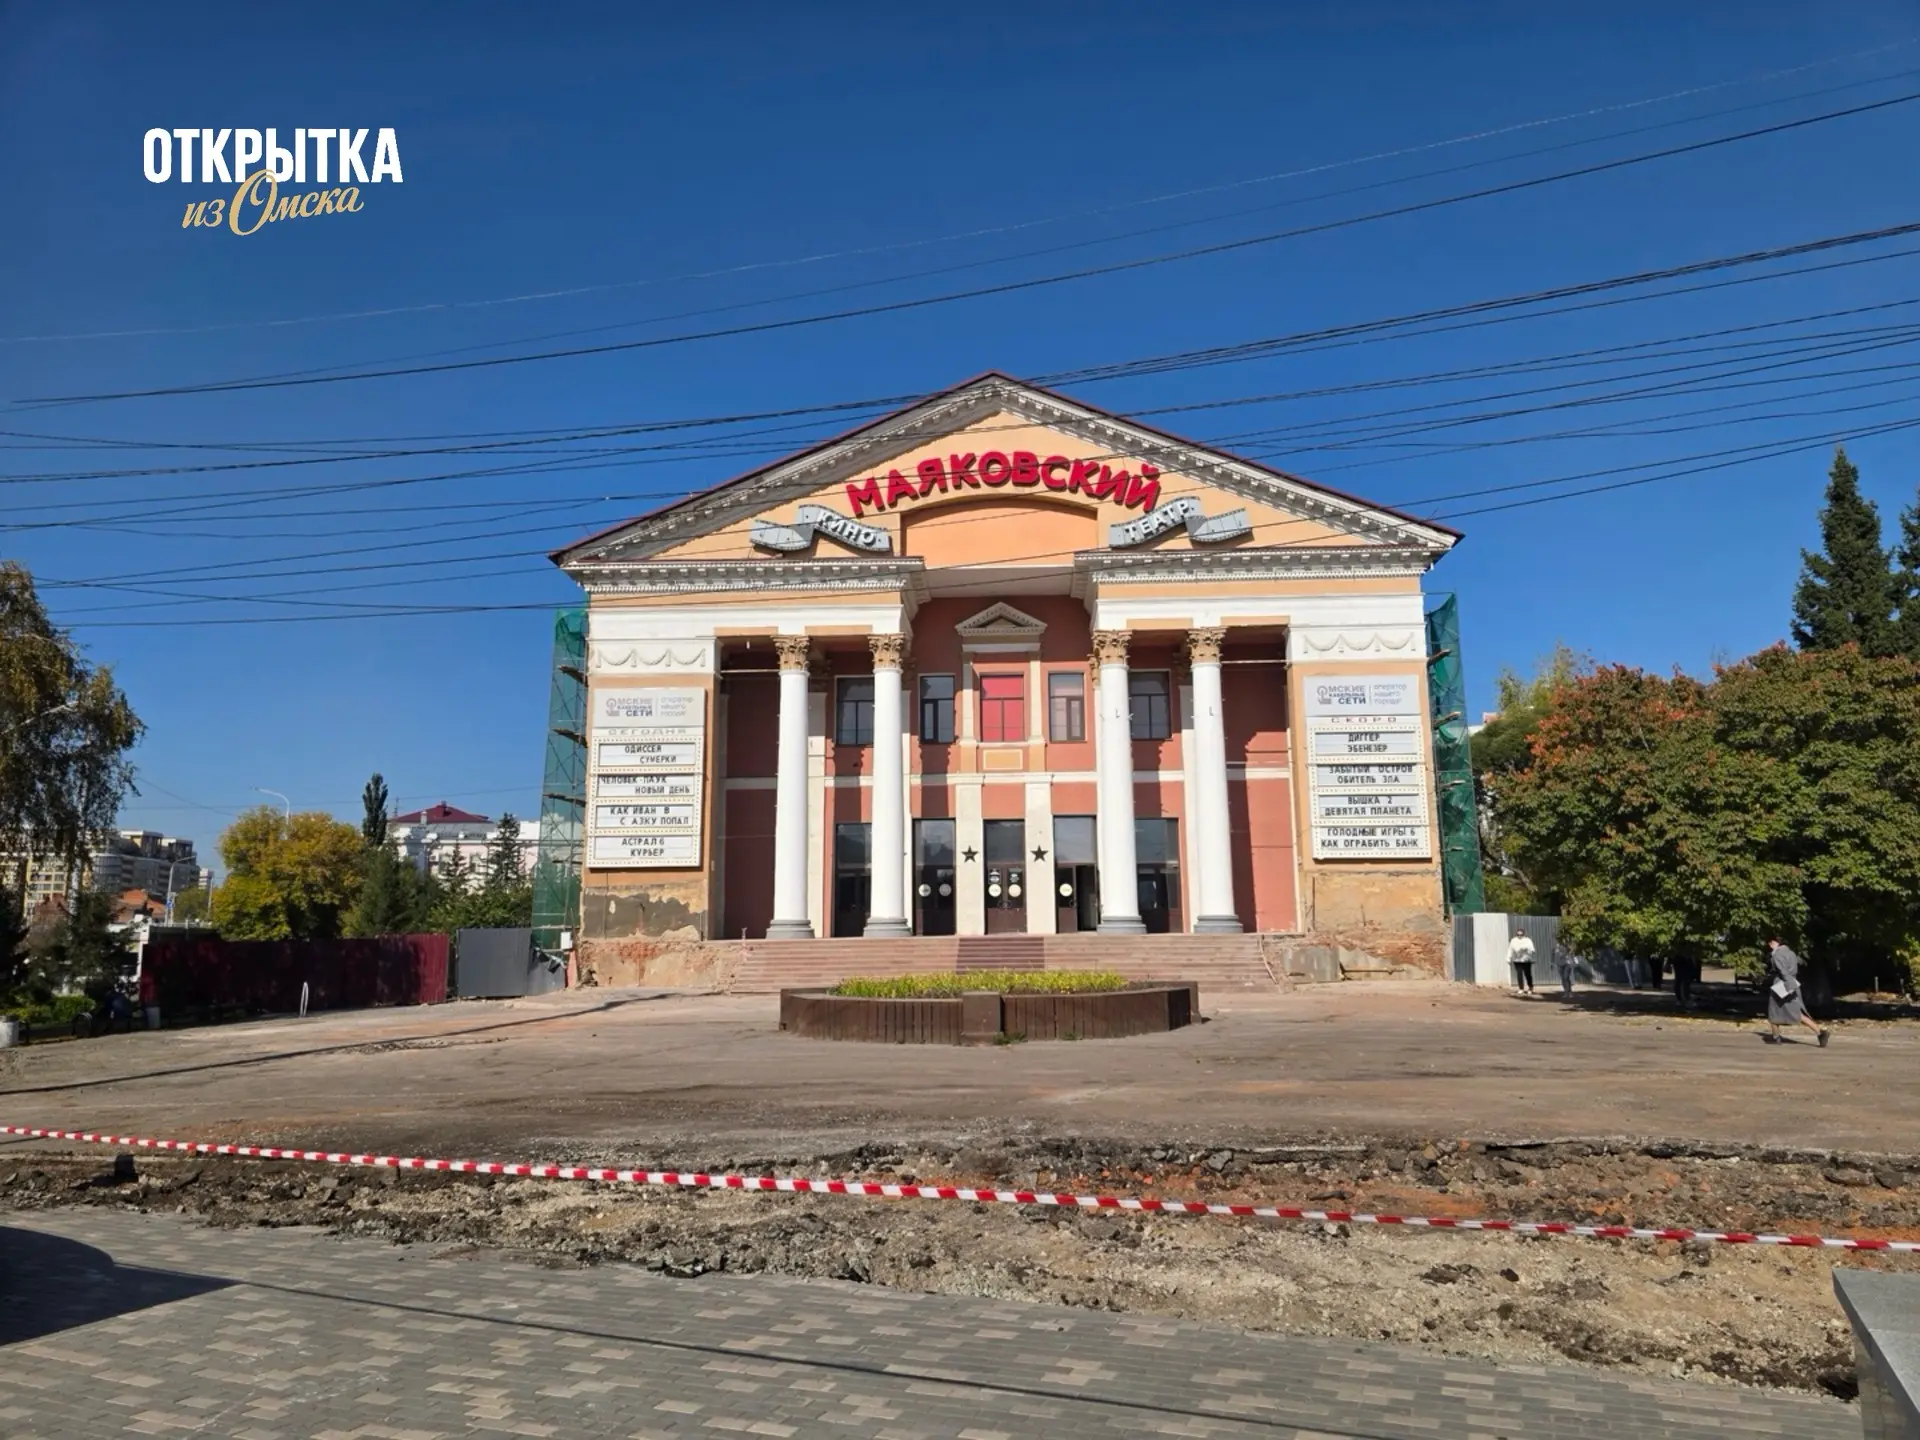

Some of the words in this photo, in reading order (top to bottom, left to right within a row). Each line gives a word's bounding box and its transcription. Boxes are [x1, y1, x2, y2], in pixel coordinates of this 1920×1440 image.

[845, 451, 1160, 517] МАЯКОВСКИЙ
[1124, 499, 1189, 541] ТЕАТР
[817, 510, 876, 546] КИНО
[1338, 697, 1366, 705] СЕТИ
[1348, 733, 1380, 743] ДИГГЕР
[625, 744, 661, 753] ОДИССЕЯ
[1347, 744, 1387, 753] ЭБЕНЕЗЕР
[640, 755, 676, 764] СУМЕРКИ
[1378, 764, 1413, 773] ОСТРОВ
[1337, 775, 1376, 784] ОБИТЕЛЬ
[1383, 775, 1400, 784] ЗЛА
[669, 785, 690, 794] ДЕНЬ
[1347, 796, 1380, 805] ВЫШКА
[1387, 796, 1392, 804] 2
[610, 806, 628, 815] КАК
[633, 806, 656, 815] ИВАН
[664, 806, 670, 814] В
[1325, 807, 1366, 816] ДЕВЯТАЯ
[1370, 807, 1412, 815] ПЛАНЕТА
[660, 817, 688, 825] ПОПАЛ
[1327, 828, 1377, 837] ГОЛОДНЫЕ
[1381, 827, 1406, 836] ИГРЫ
[1410, 828, 1416, 836] 6
[622, 838, 656, 846] АСТРАЛ
[1321, 839, 1338, 848] КАК
[1343, 839, 1390, 848] ОГРАБИТЬ
[1396, 838, 1418, 847] БАНК
[631, 848, 664, 857] КУРЬЕР
